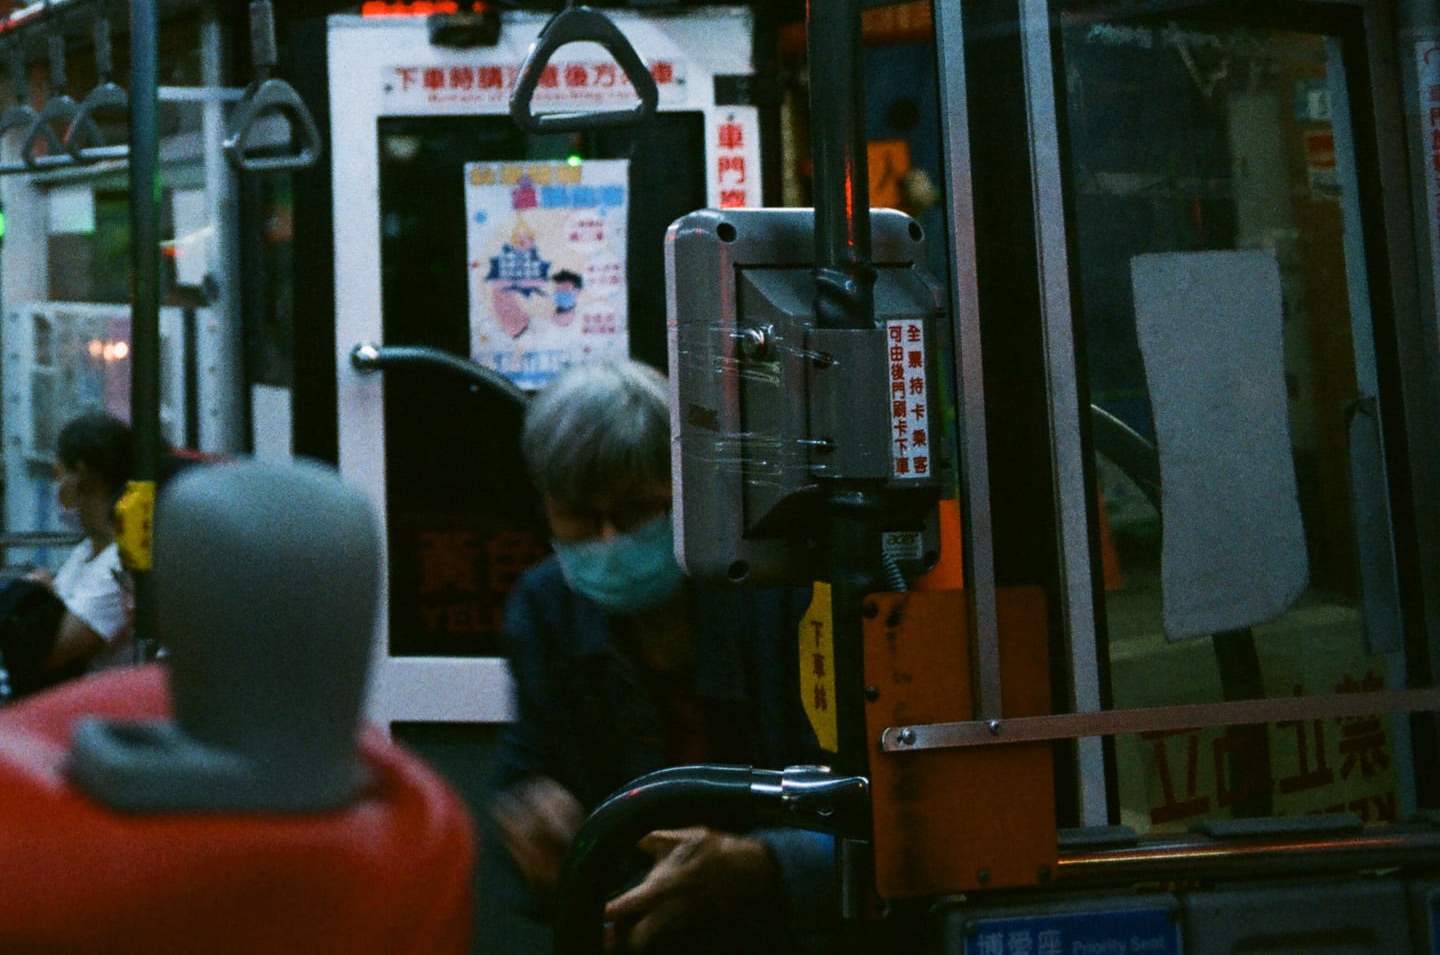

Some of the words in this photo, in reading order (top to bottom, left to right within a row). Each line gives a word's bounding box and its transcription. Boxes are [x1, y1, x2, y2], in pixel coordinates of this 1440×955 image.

[888, 325, 910, 475] 可由後門刷卡下車
[906, 324, 928, 475] 全票持卡乘客
